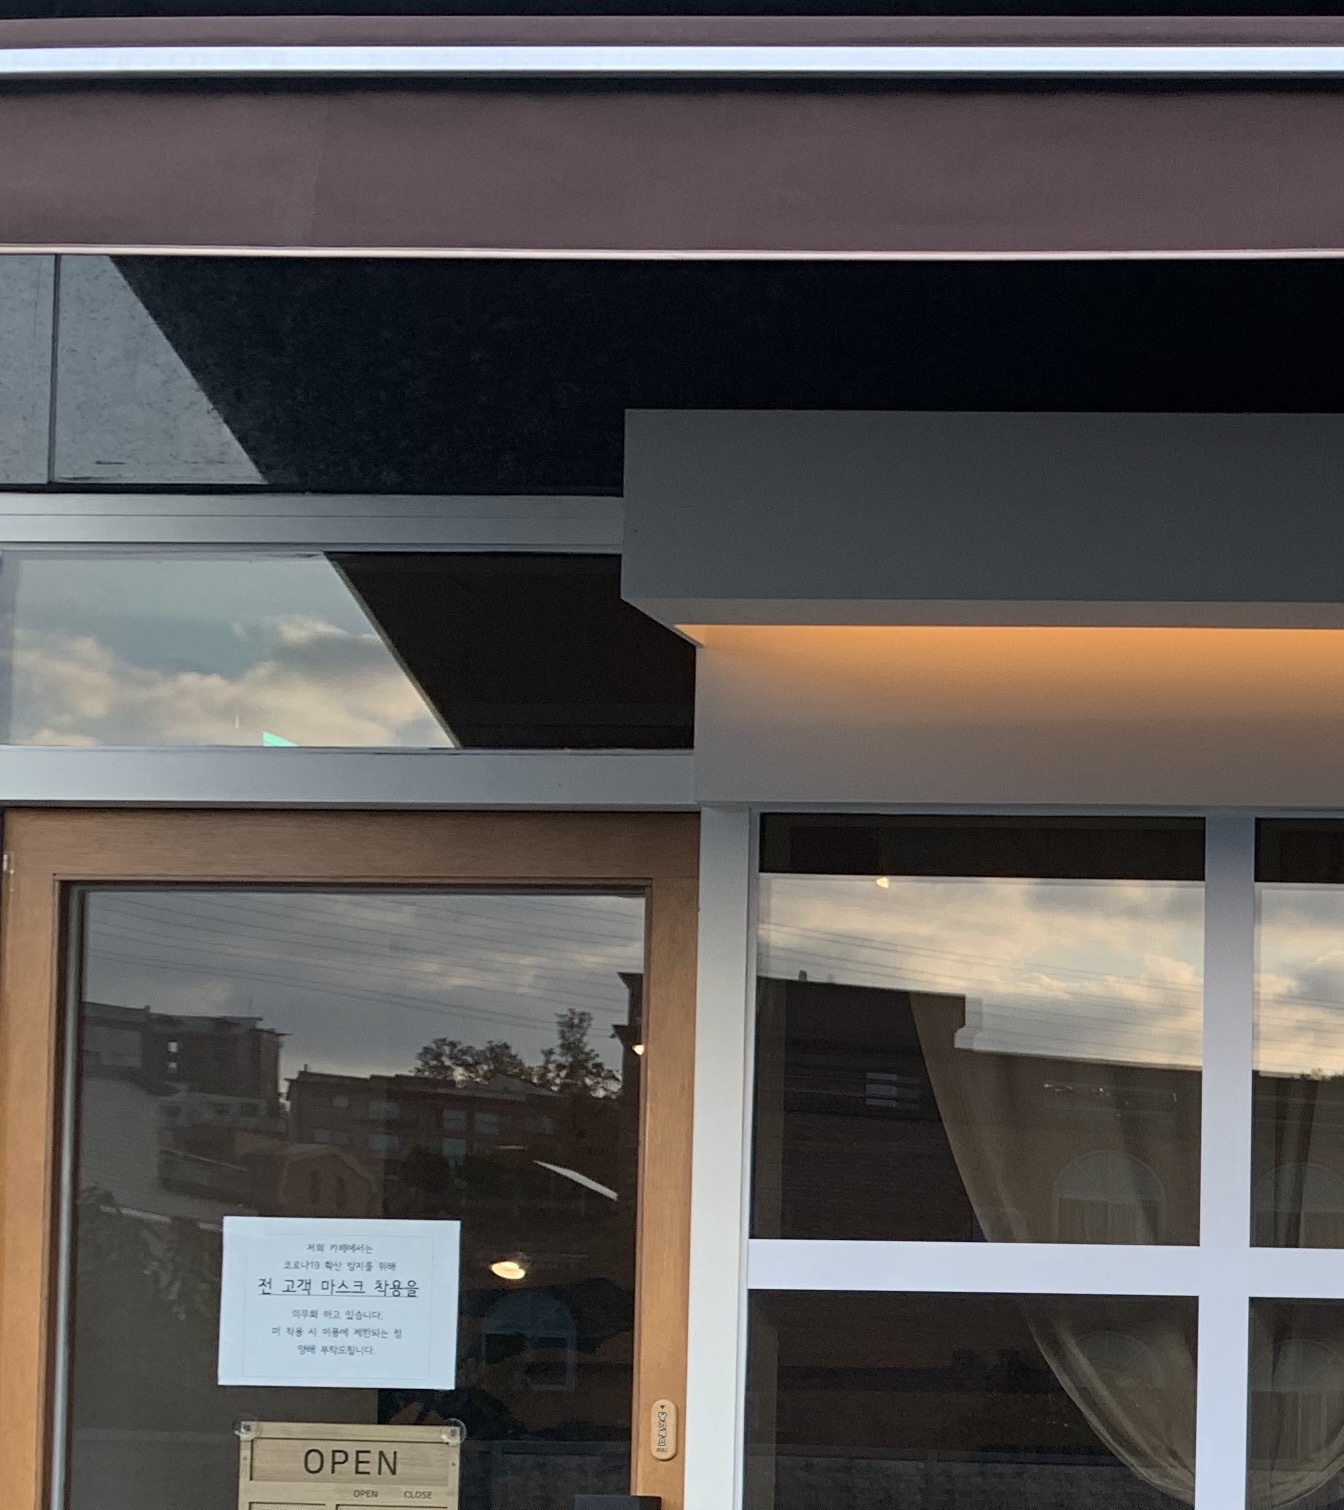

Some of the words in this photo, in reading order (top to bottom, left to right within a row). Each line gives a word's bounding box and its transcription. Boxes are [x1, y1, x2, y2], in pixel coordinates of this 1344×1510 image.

[306, 1243, 325, 1253] 저희
[329, 1243, 374, 1255] 카페에서는
[283, 1260, 320, 1271] 코로나19
[324, 1260, 343, 1272] 확산
[347, 1261, 374, 1272] 방지를
[379, 1261, 397, 1272] 위해
[258, 1278, 273, 1295] 전
[282, 1278, 312, 1296] 고객
[320, 1279, 366, 1296] 마스크
[374, 1279, 420, 1297] 착용을
[292, 1309, 319, 1320] 의무화
[323, 1309, 341, 1320] 하고
[272, 1327, 281, 1337] 미
[286, 1327, 303, 1338] 착용
[307, 1327, 317, 1337] 시
[322, 1327, 349, 1338] 이용에
[353, 1327, 389, 1339] 제한되는
[393, 1328, 403, 1339] 점
[303, 1448, 399, 1476] OPEN
[352, 1489, 379, 1499] OPEN
[403, 1490, 433, 1500] CLOSE
